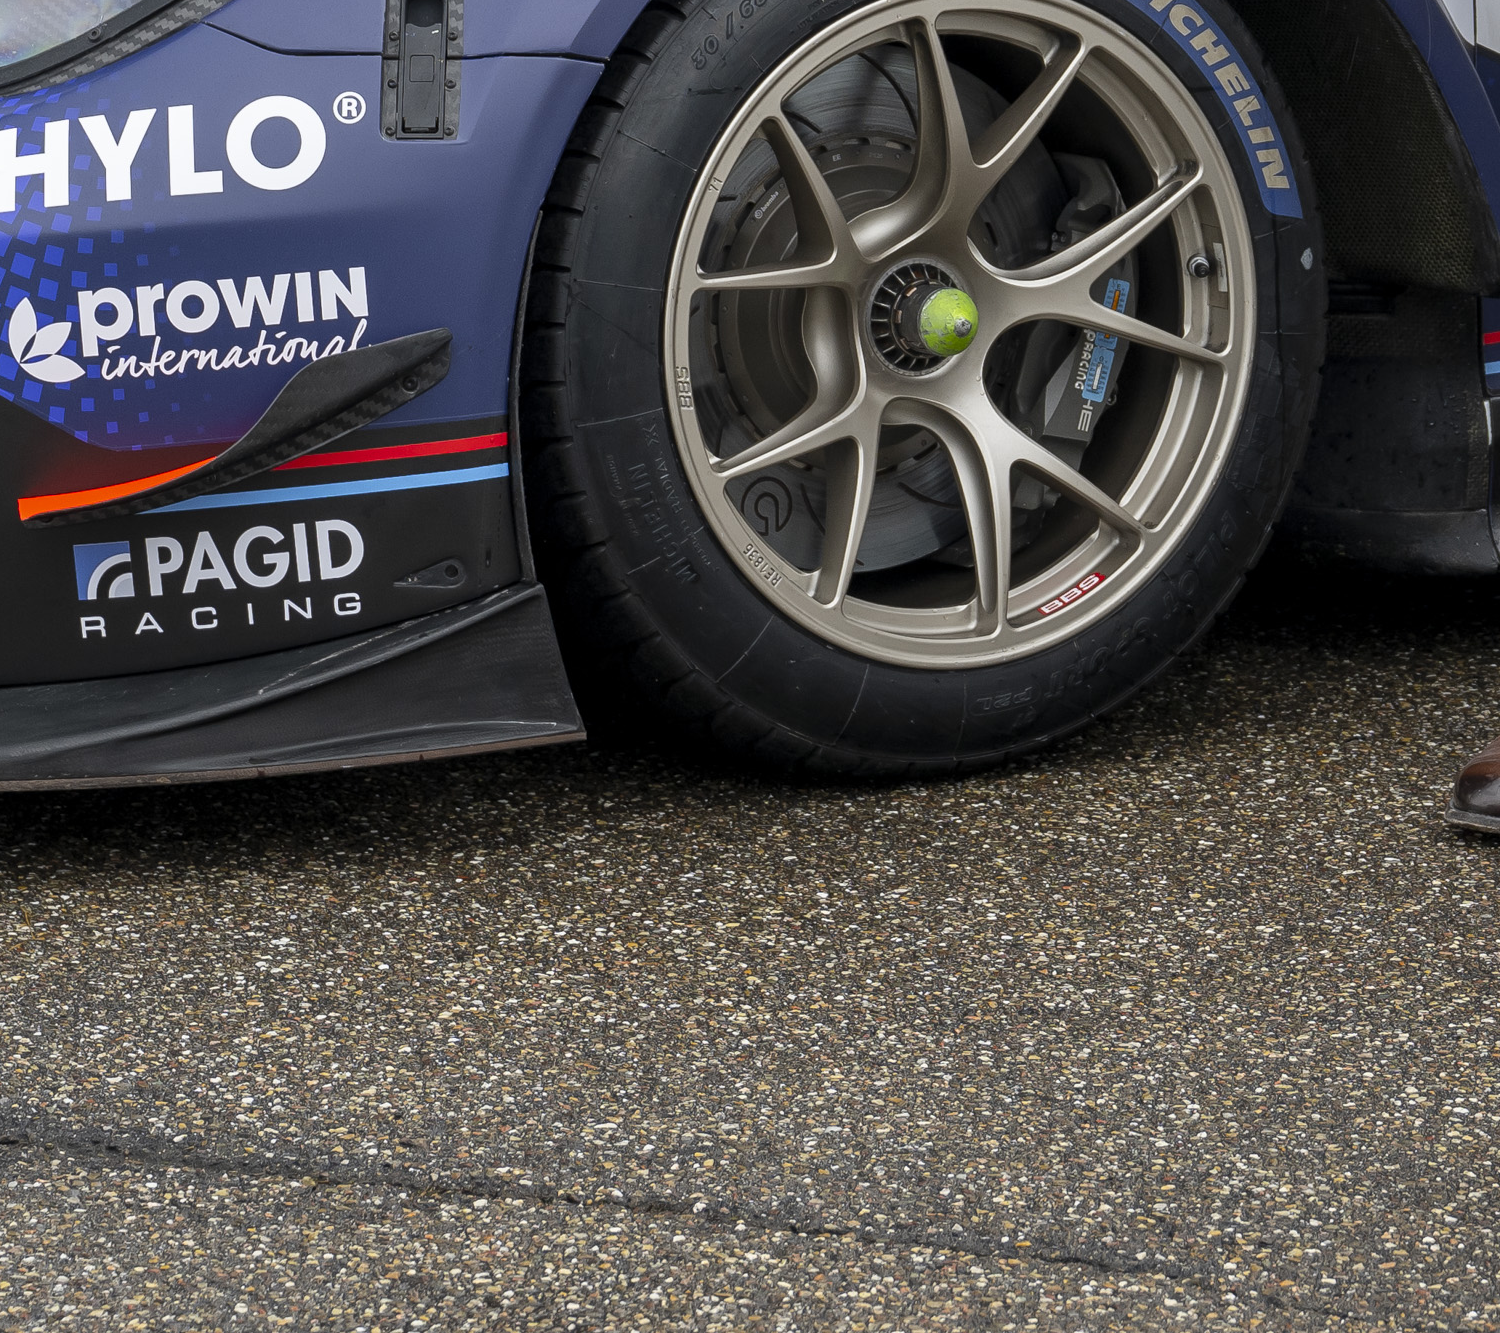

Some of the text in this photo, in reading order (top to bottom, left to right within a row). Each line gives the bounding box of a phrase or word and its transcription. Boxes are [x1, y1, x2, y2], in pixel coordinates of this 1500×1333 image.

[145, 519, 365, 597] PAGID
[79, 592, 362, 639] RACING
[1042, 574, 1100, 614] BBS
